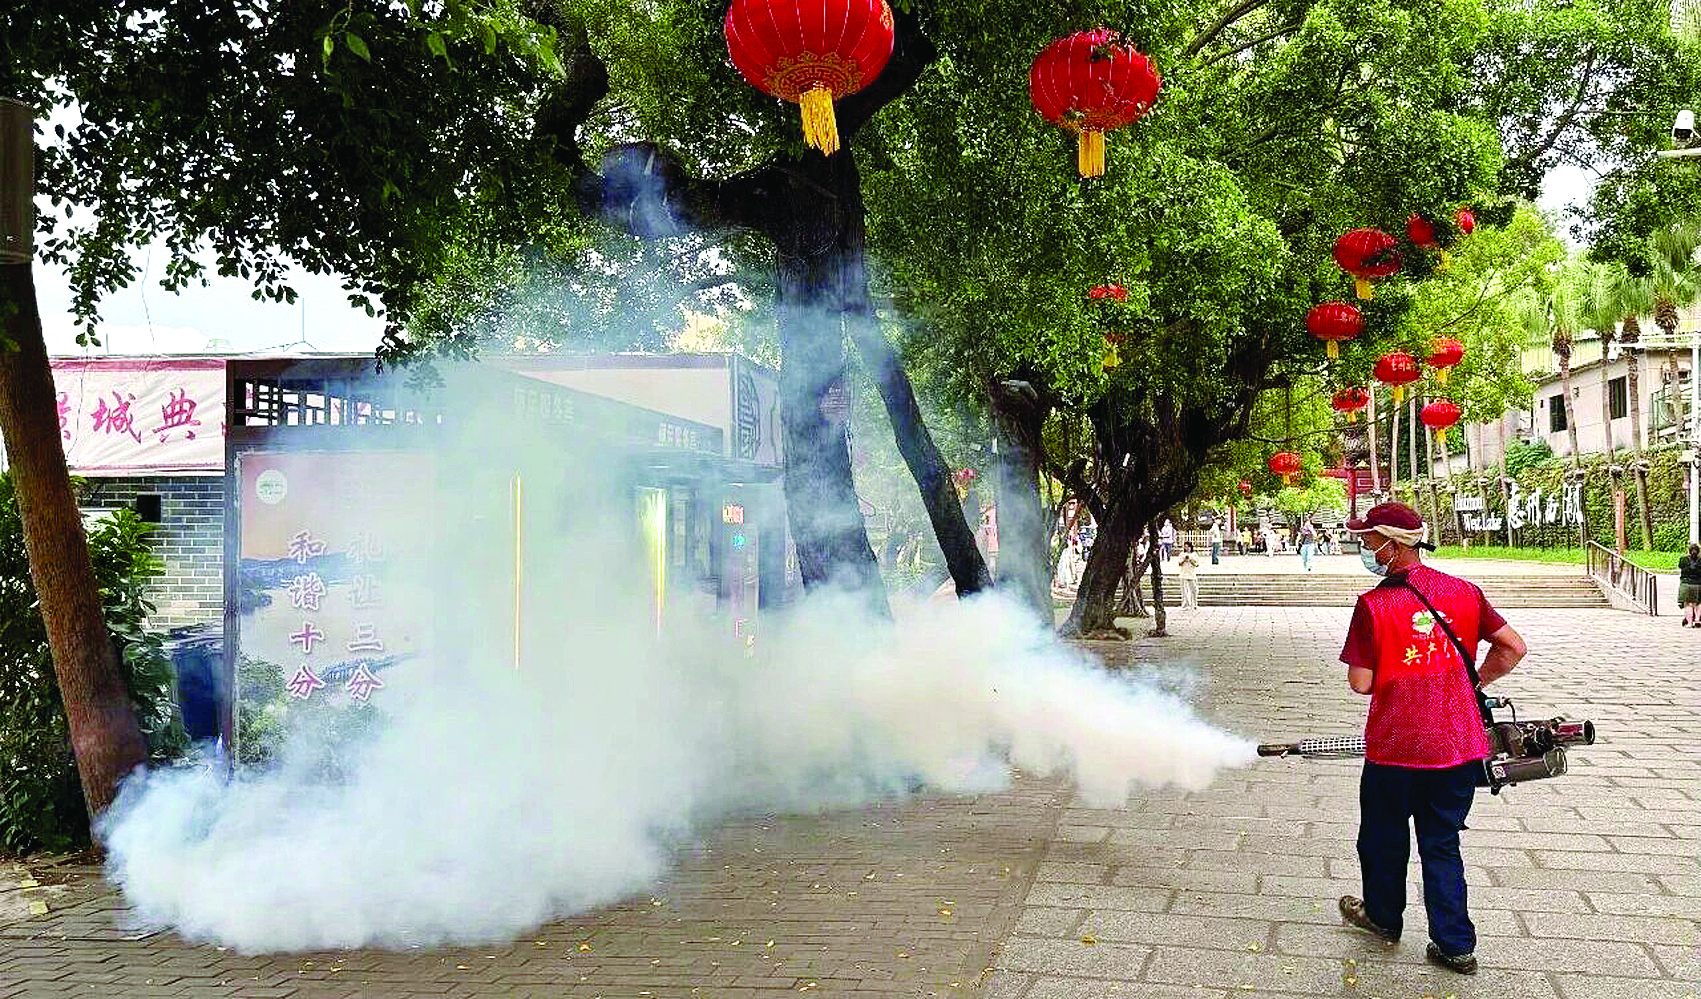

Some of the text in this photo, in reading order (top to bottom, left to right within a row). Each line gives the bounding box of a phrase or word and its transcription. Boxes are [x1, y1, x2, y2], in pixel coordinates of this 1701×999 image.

[57, 387, 201, 443] 城典
[287, 530, 326, 700] 和谐十分
